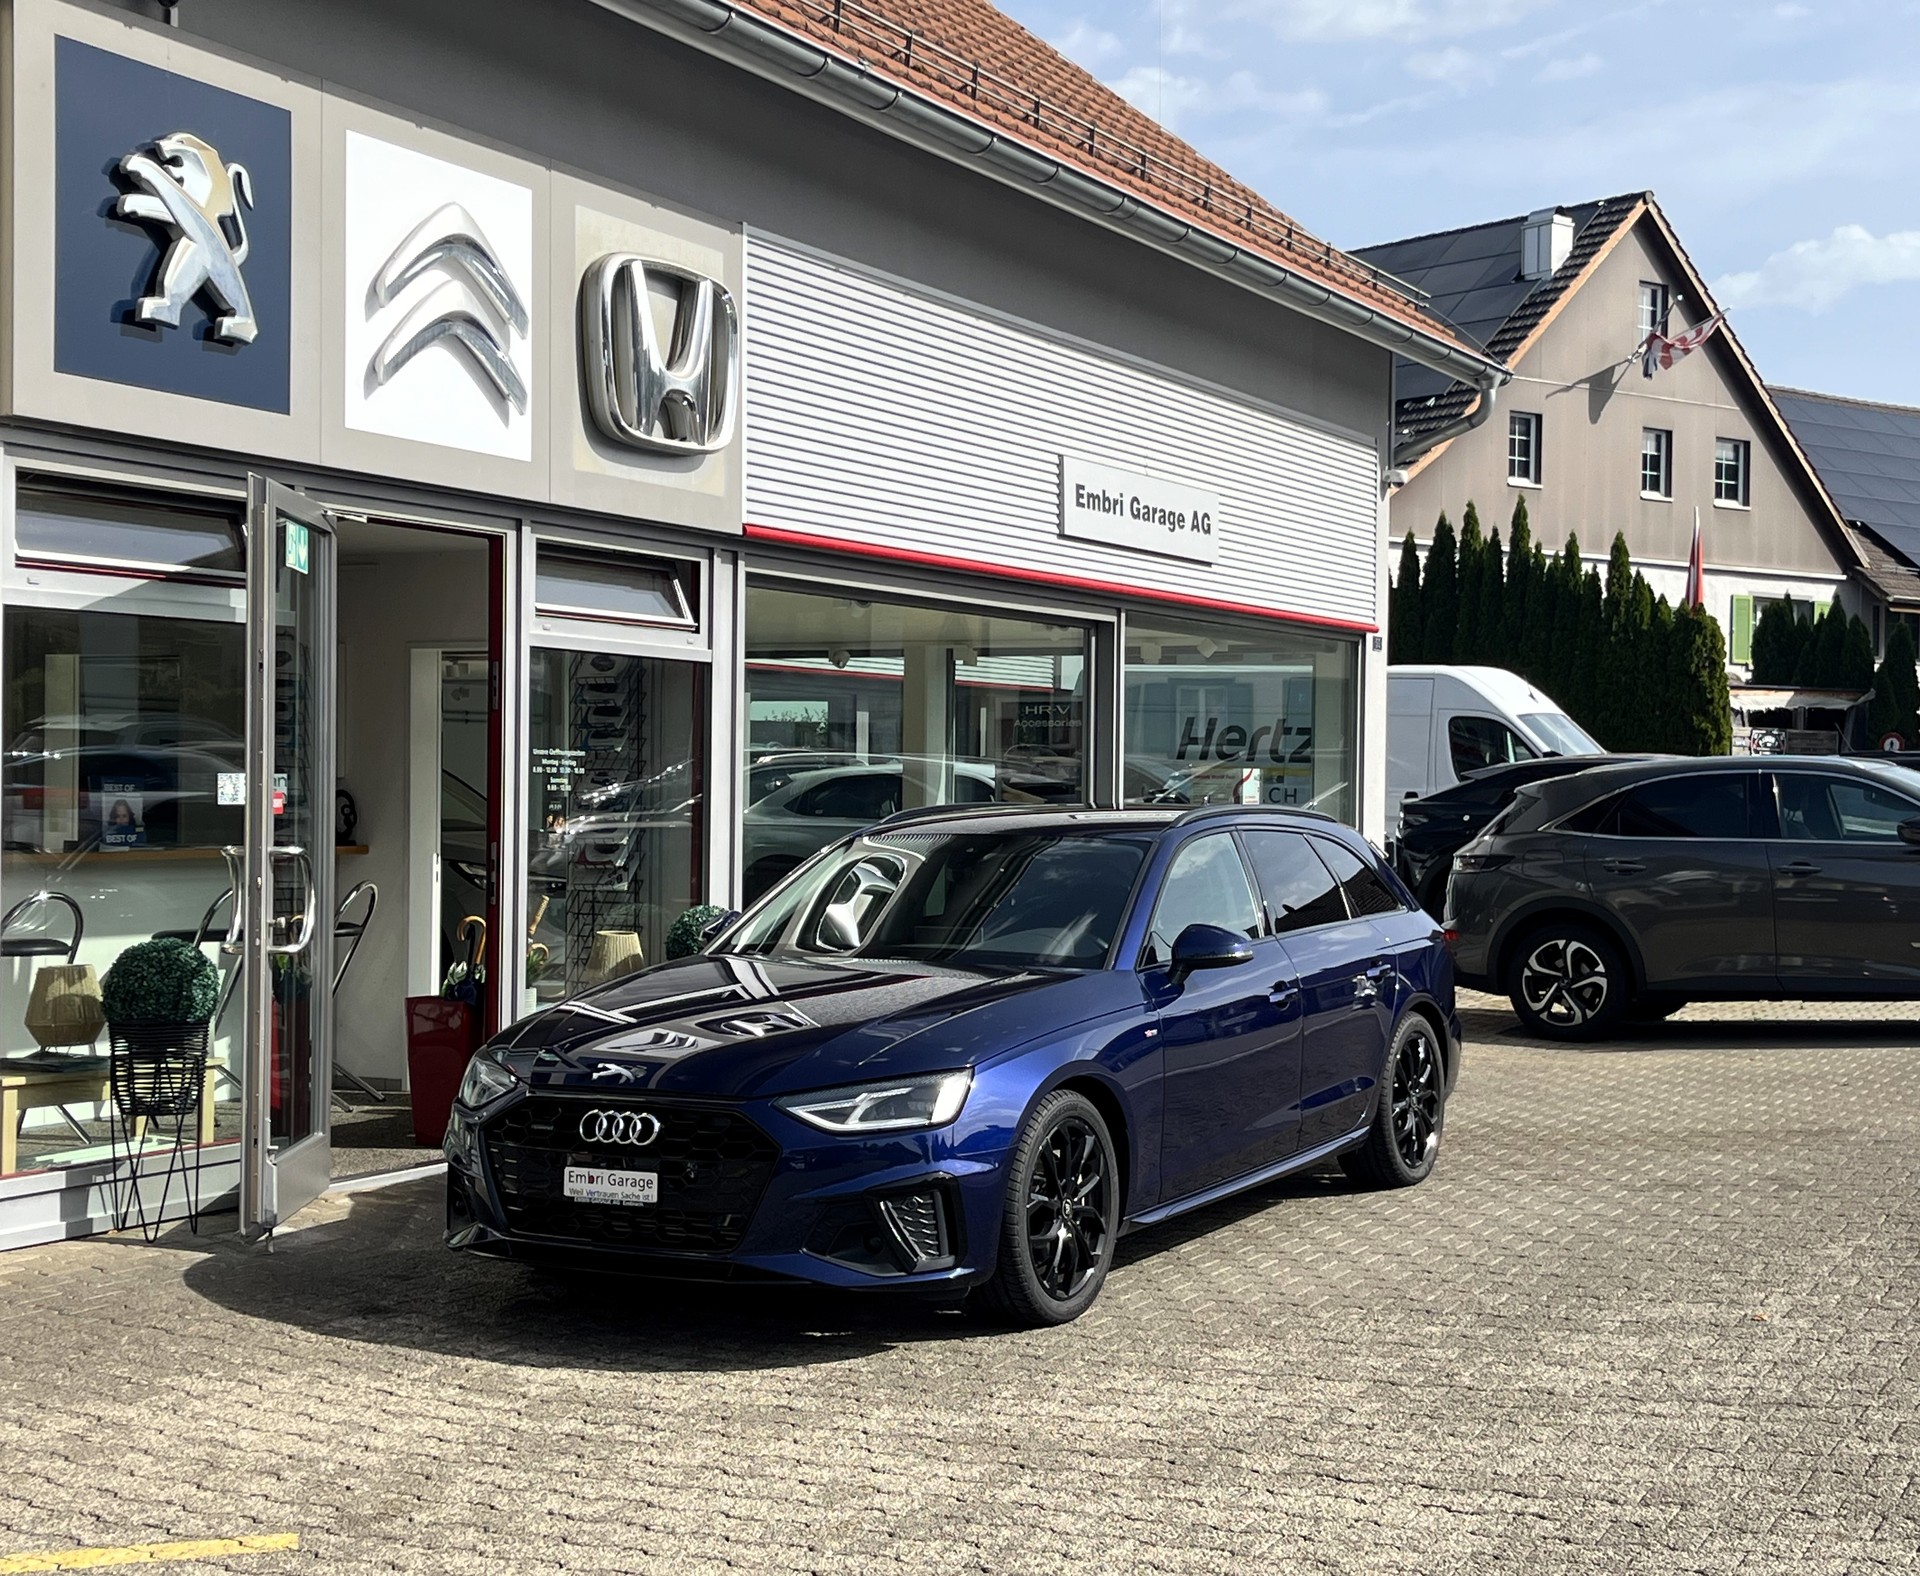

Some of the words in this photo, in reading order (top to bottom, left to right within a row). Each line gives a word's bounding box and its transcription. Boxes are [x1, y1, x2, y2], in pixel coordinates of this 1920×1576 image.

[1075, 483, 1124, 516] Embri
[1129, 496, 1186, 533] Garage
[1190, 510, 1212, 535] AG
[1025, 705, 1070, 715] HR-V
[1014, 719, 1082, 728] Accessories
[1176, 716, 1312, 764] Hertz
[103, 783, 124, 792] BEST
[124, 784, 135, 792] OF
[106, 834, 126, 843] BEST
[126, 834, 138, 843] OF
[568, 1170, 604, 1185] Embri
[607, 1173, 654, 1192] Garage
[569, 1187, 584, 1196] Weil
[586, 1188, 619, 1198] Vertrauen
[620, 1191, 641, 1200] Sache
